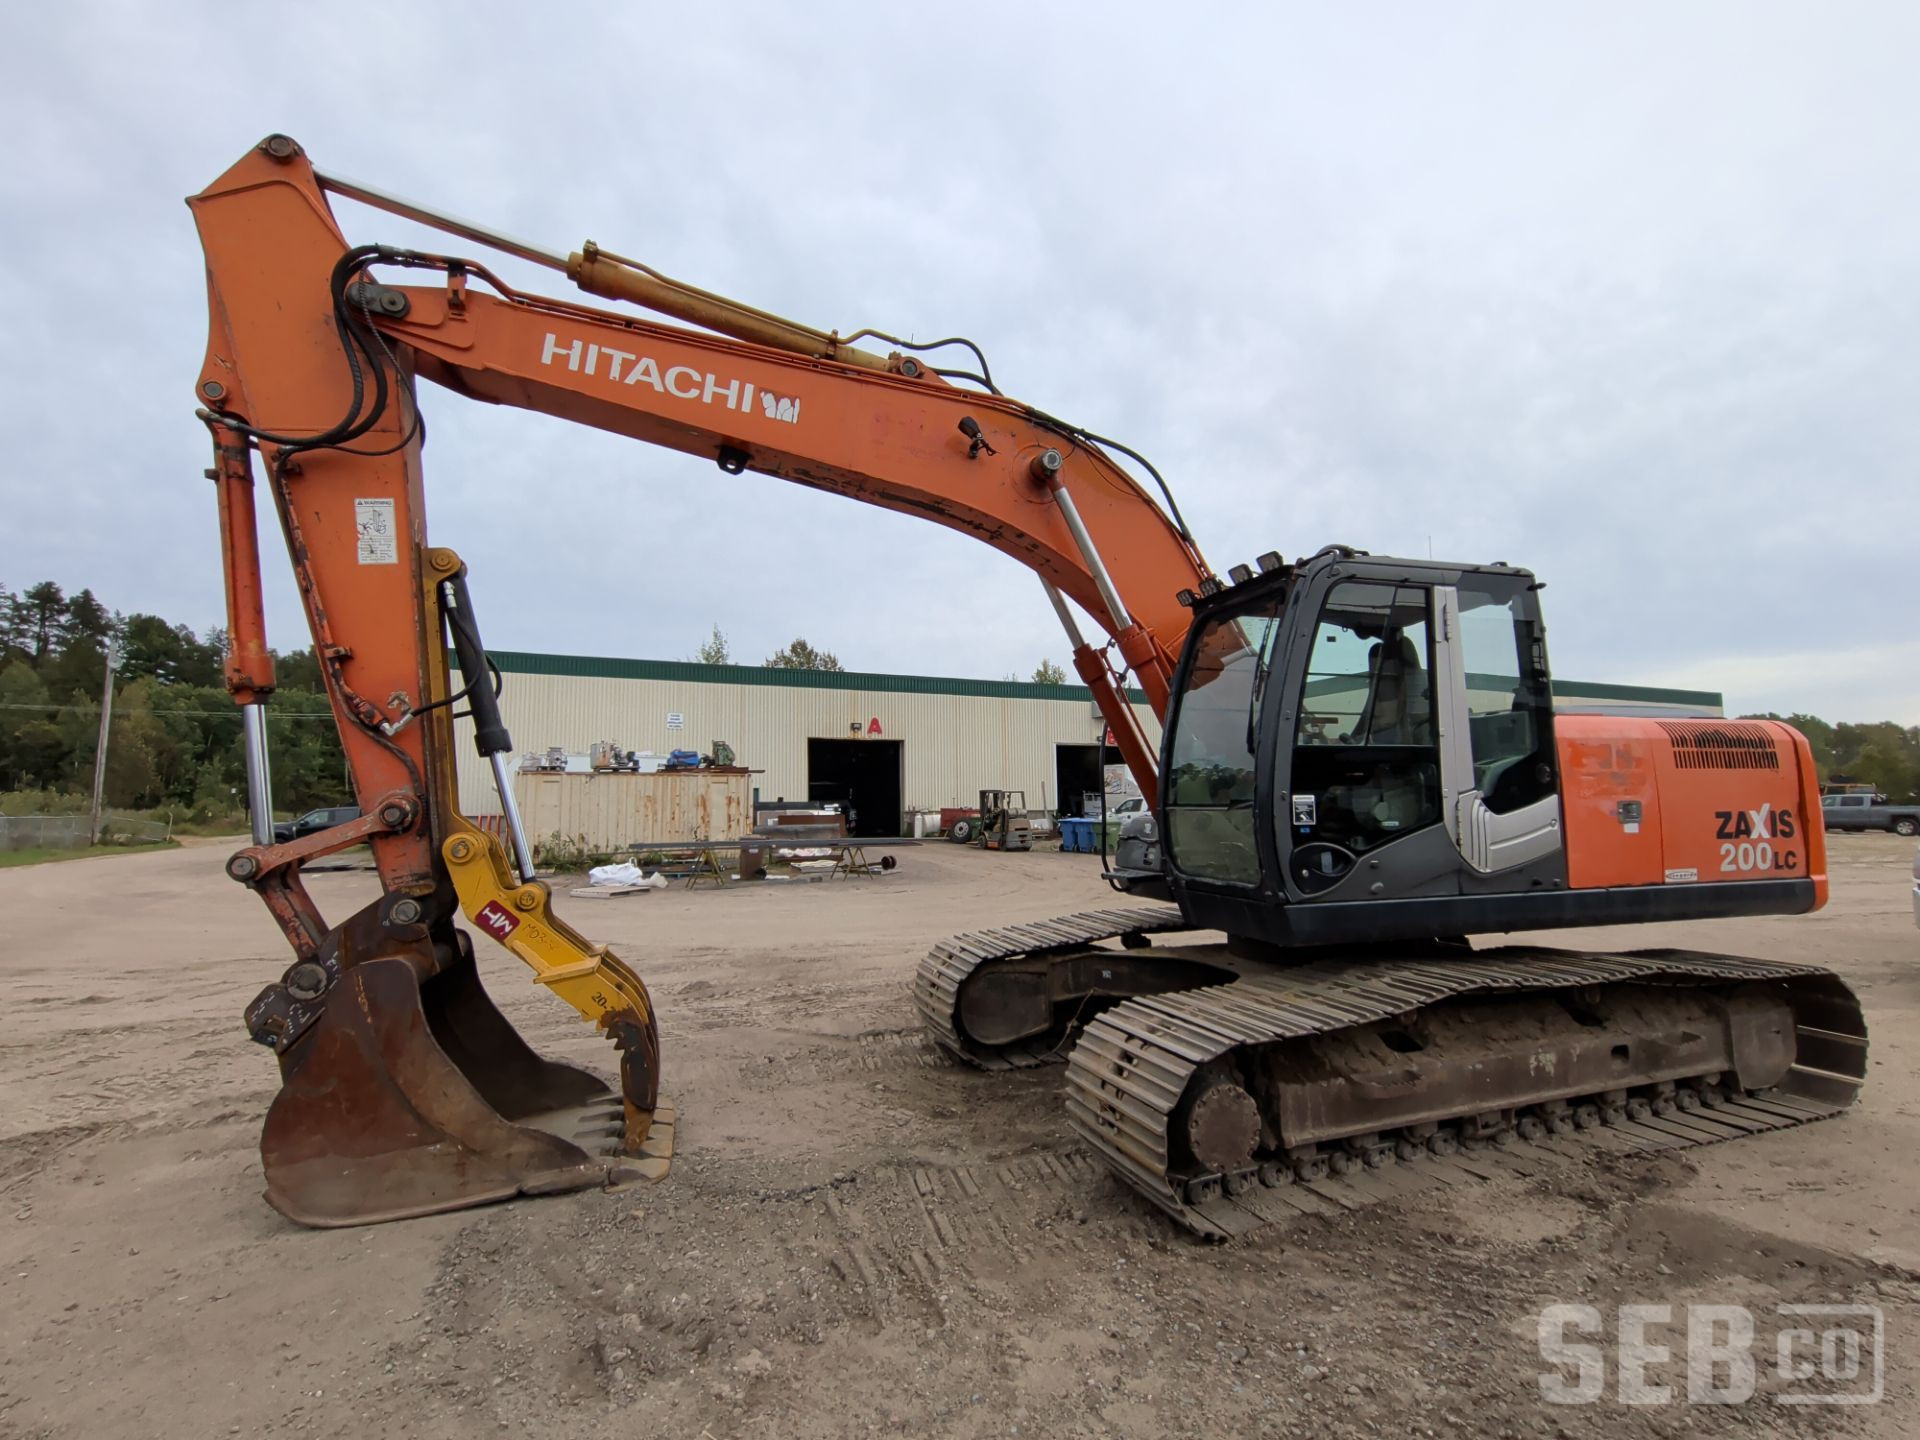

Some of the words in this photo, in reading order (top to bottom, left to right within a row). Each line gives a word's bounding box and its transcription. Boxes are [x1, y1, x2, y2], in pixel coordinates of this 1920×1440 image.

[541, 333, 754, 413] HITACHI
[866, 716, 883, 735] A
[1715, 803, 1795, 839] ZAXIS
